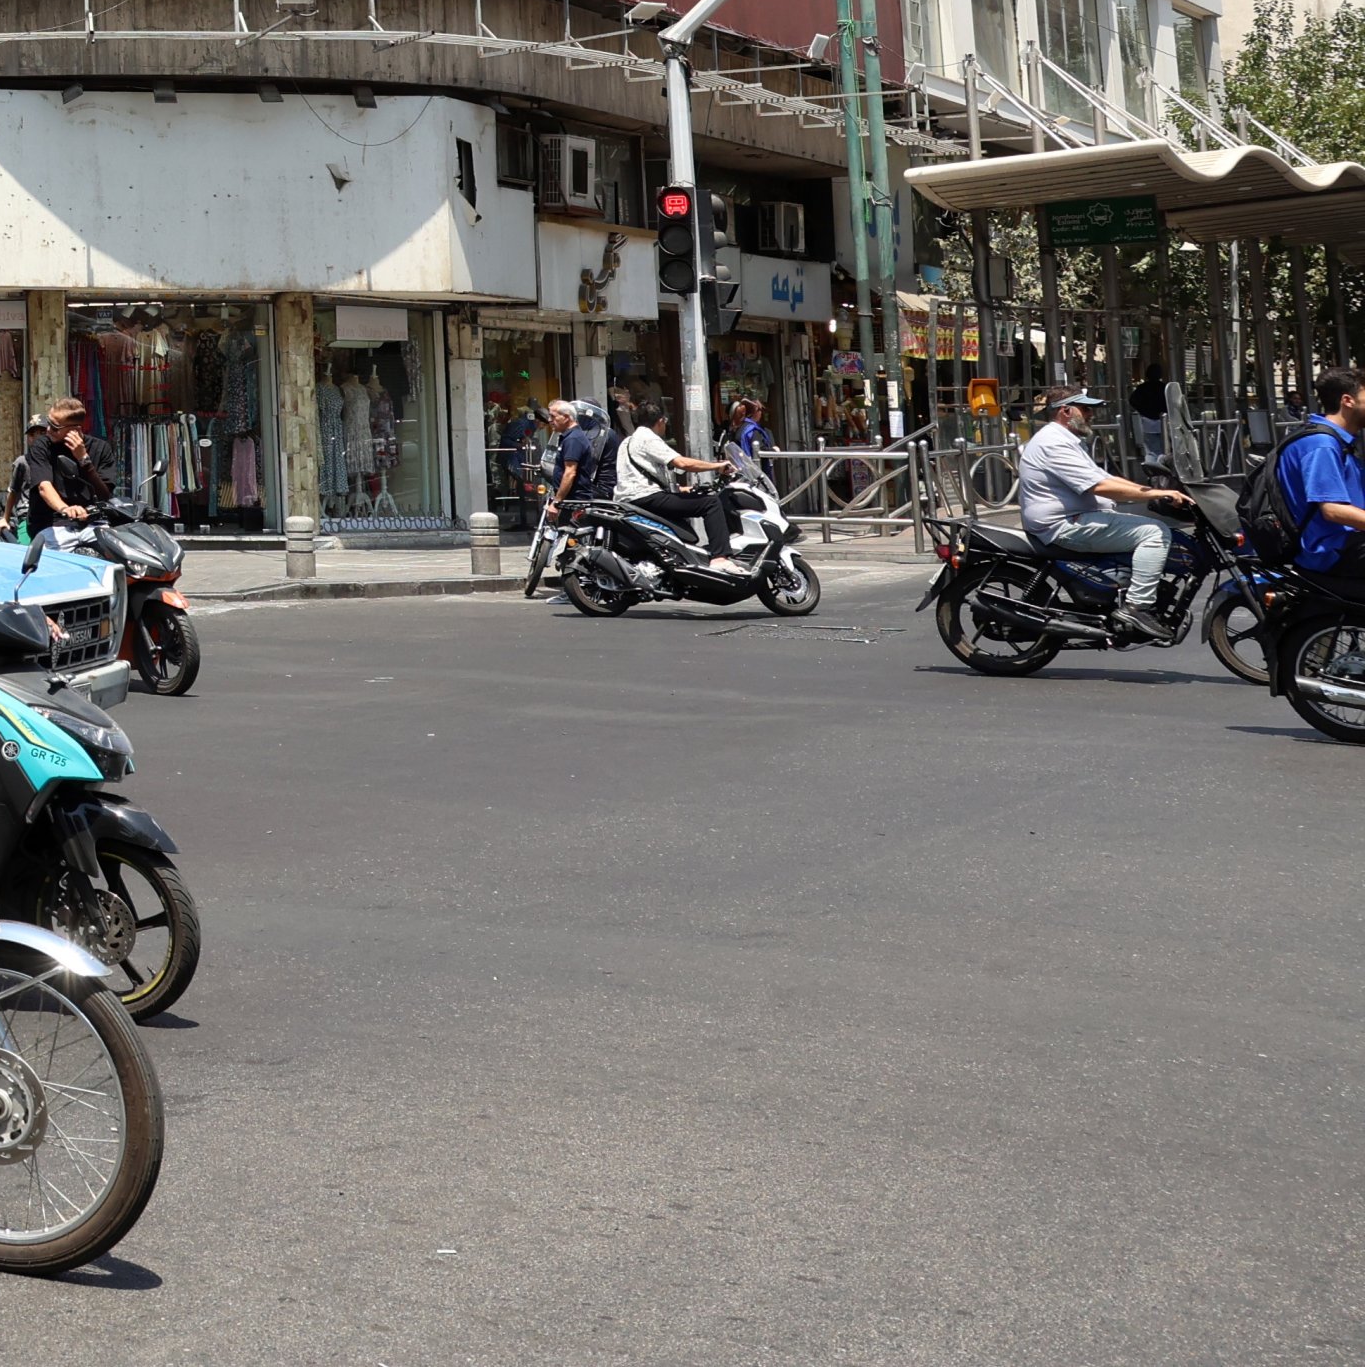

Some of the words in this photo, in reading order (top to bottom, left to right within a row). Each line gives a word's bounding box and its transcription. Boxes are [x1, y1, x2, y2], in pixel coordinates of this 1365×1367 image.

[772, 267, 804, 313] ترمه
[69, 627, 93, 646] NISSAN
[30, 747, 47, 761] GR
[49, 753, 67, 767] 125
